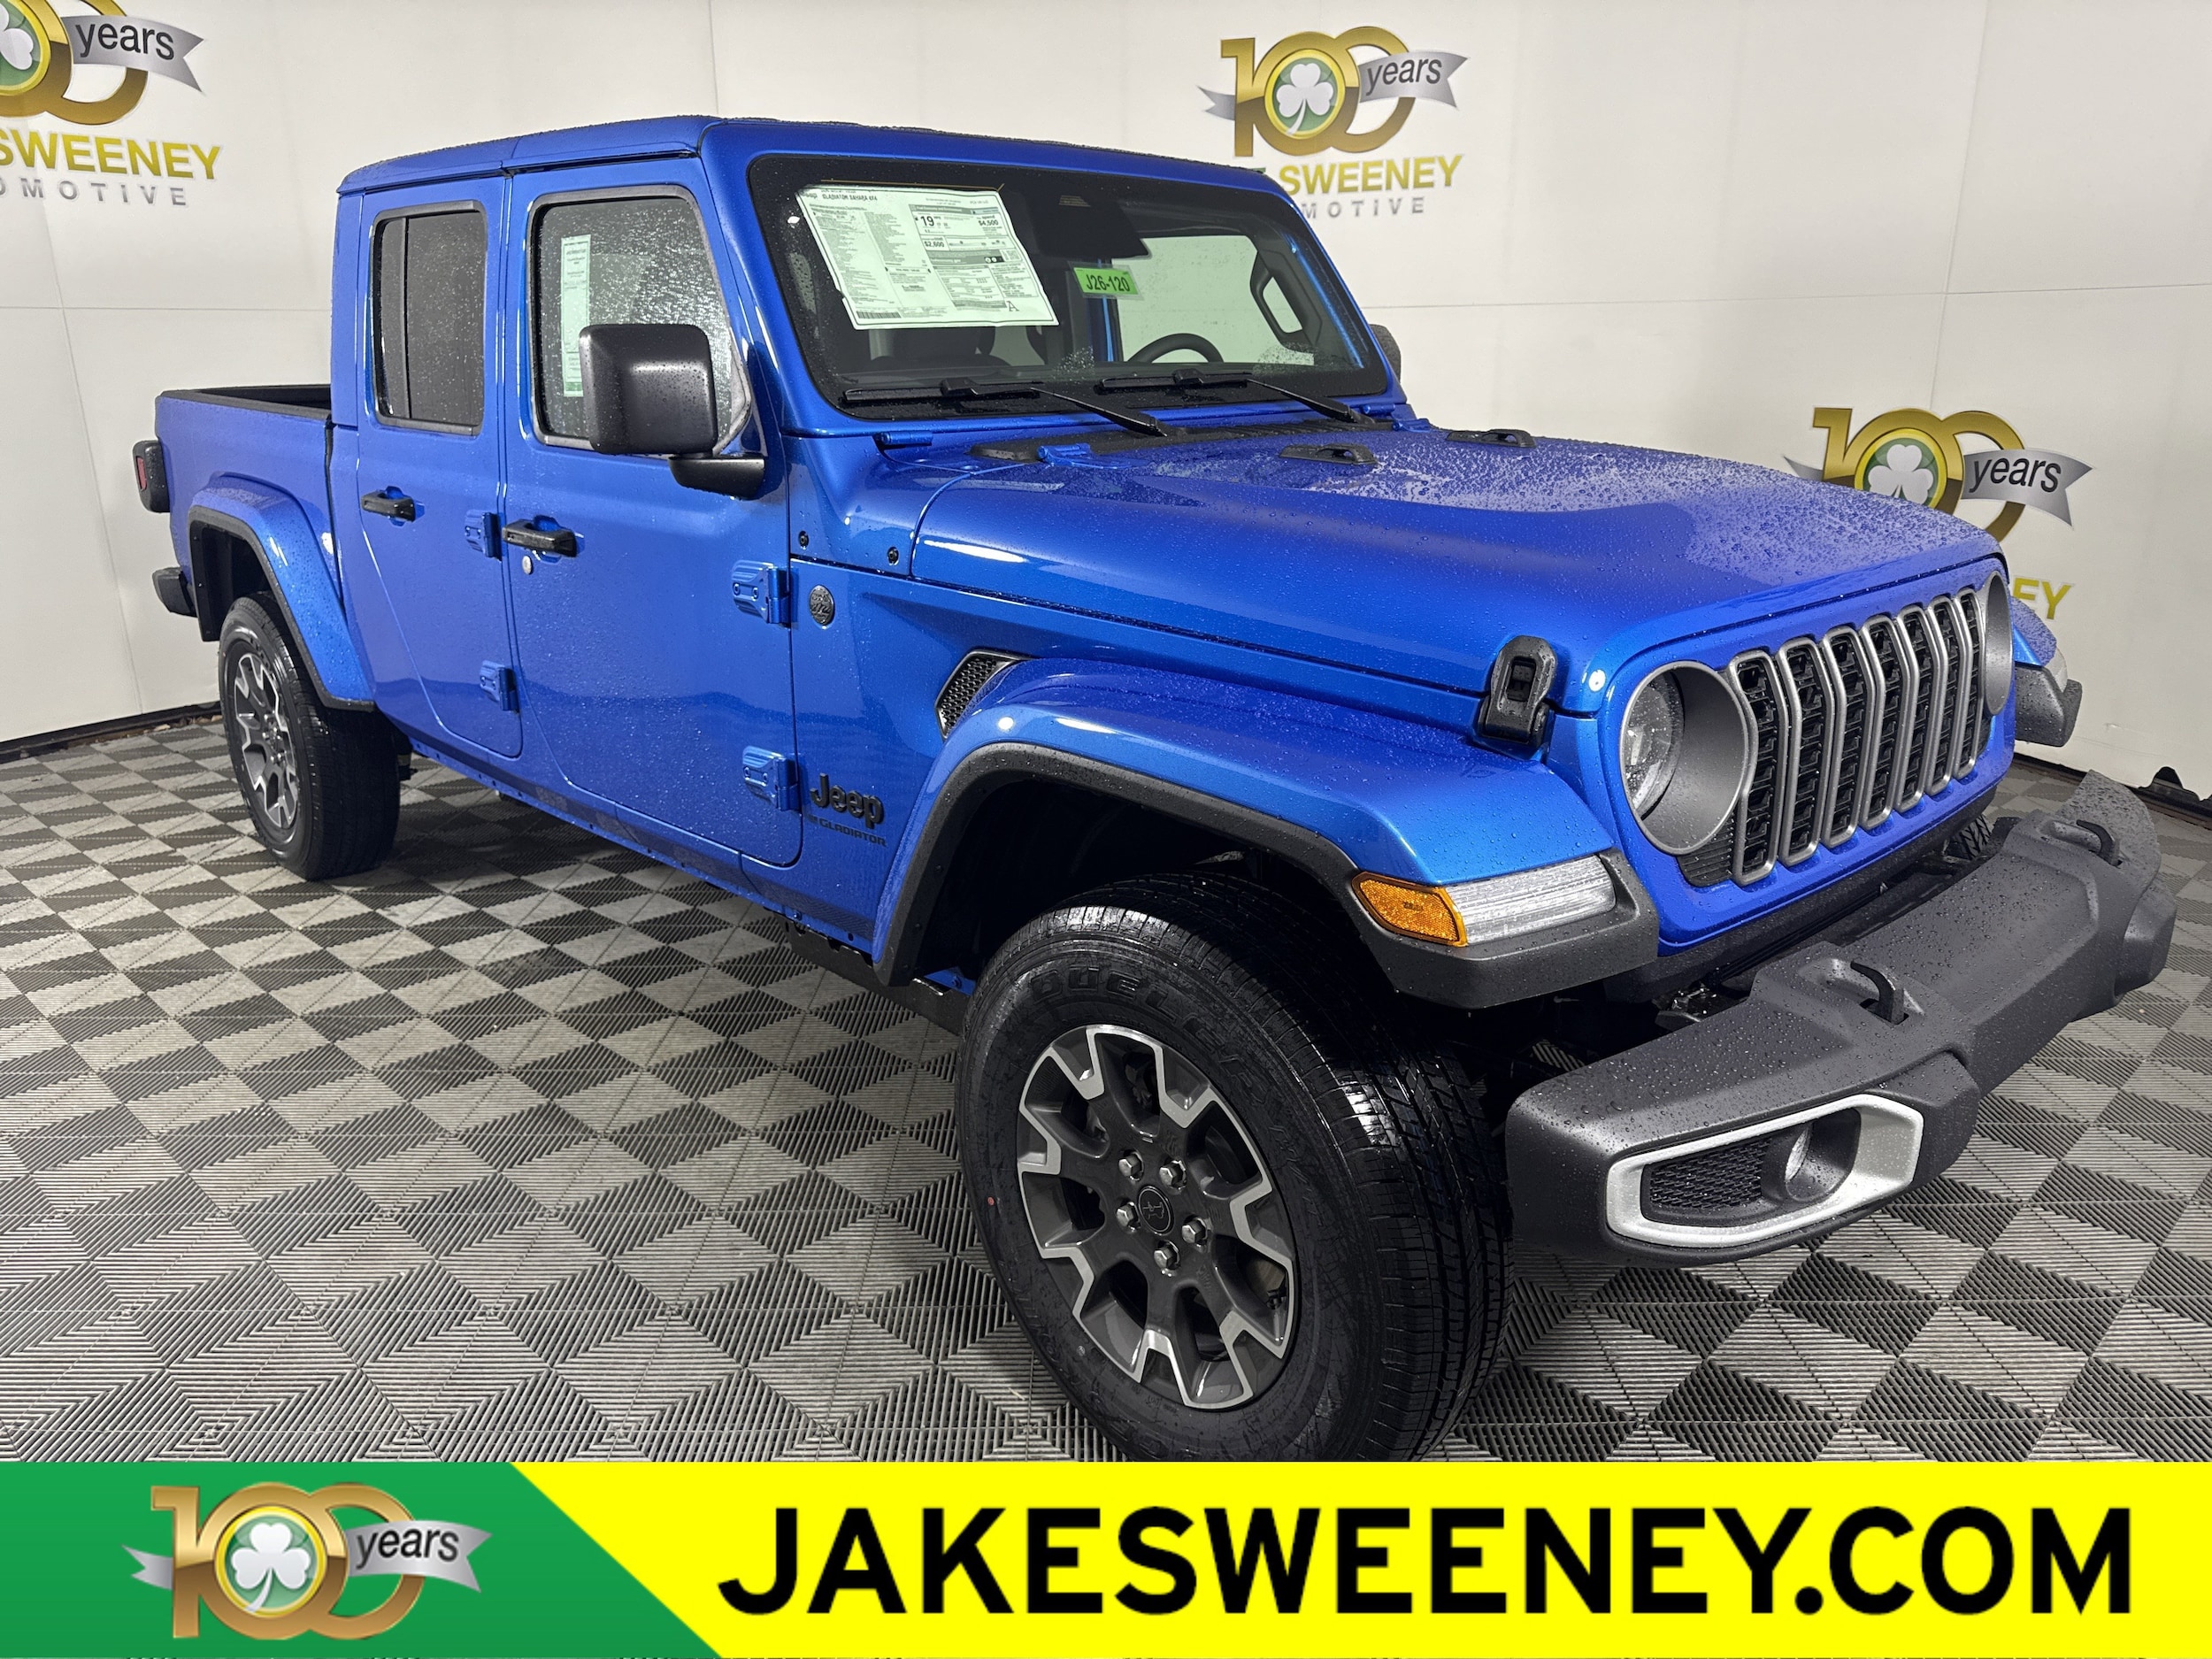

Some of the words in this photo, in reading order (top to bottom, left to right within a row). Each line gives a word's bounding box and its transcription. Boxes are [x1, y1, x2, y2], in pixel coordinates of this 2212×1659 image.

[75, 22, 175, 61] years
[1220, 26, 1417, 157] 100
[1365, 58, 1443, 96] years
[0, 177, 187, 206] MOTIVE
[1279, 154, 1463, 196] SWEENEY
[920, 215, 934, 227] 19
[1301, 196, 1425, 219] MOTIVE
[1086, 273, 1131, 292] J26-120
[1969, 457, 2062, 493] years
[810, 772, 885, 830] Jeep
[819, 818, 887, 848] GLADIATOR
[1029, 964, 1269, 1106] DUELER
